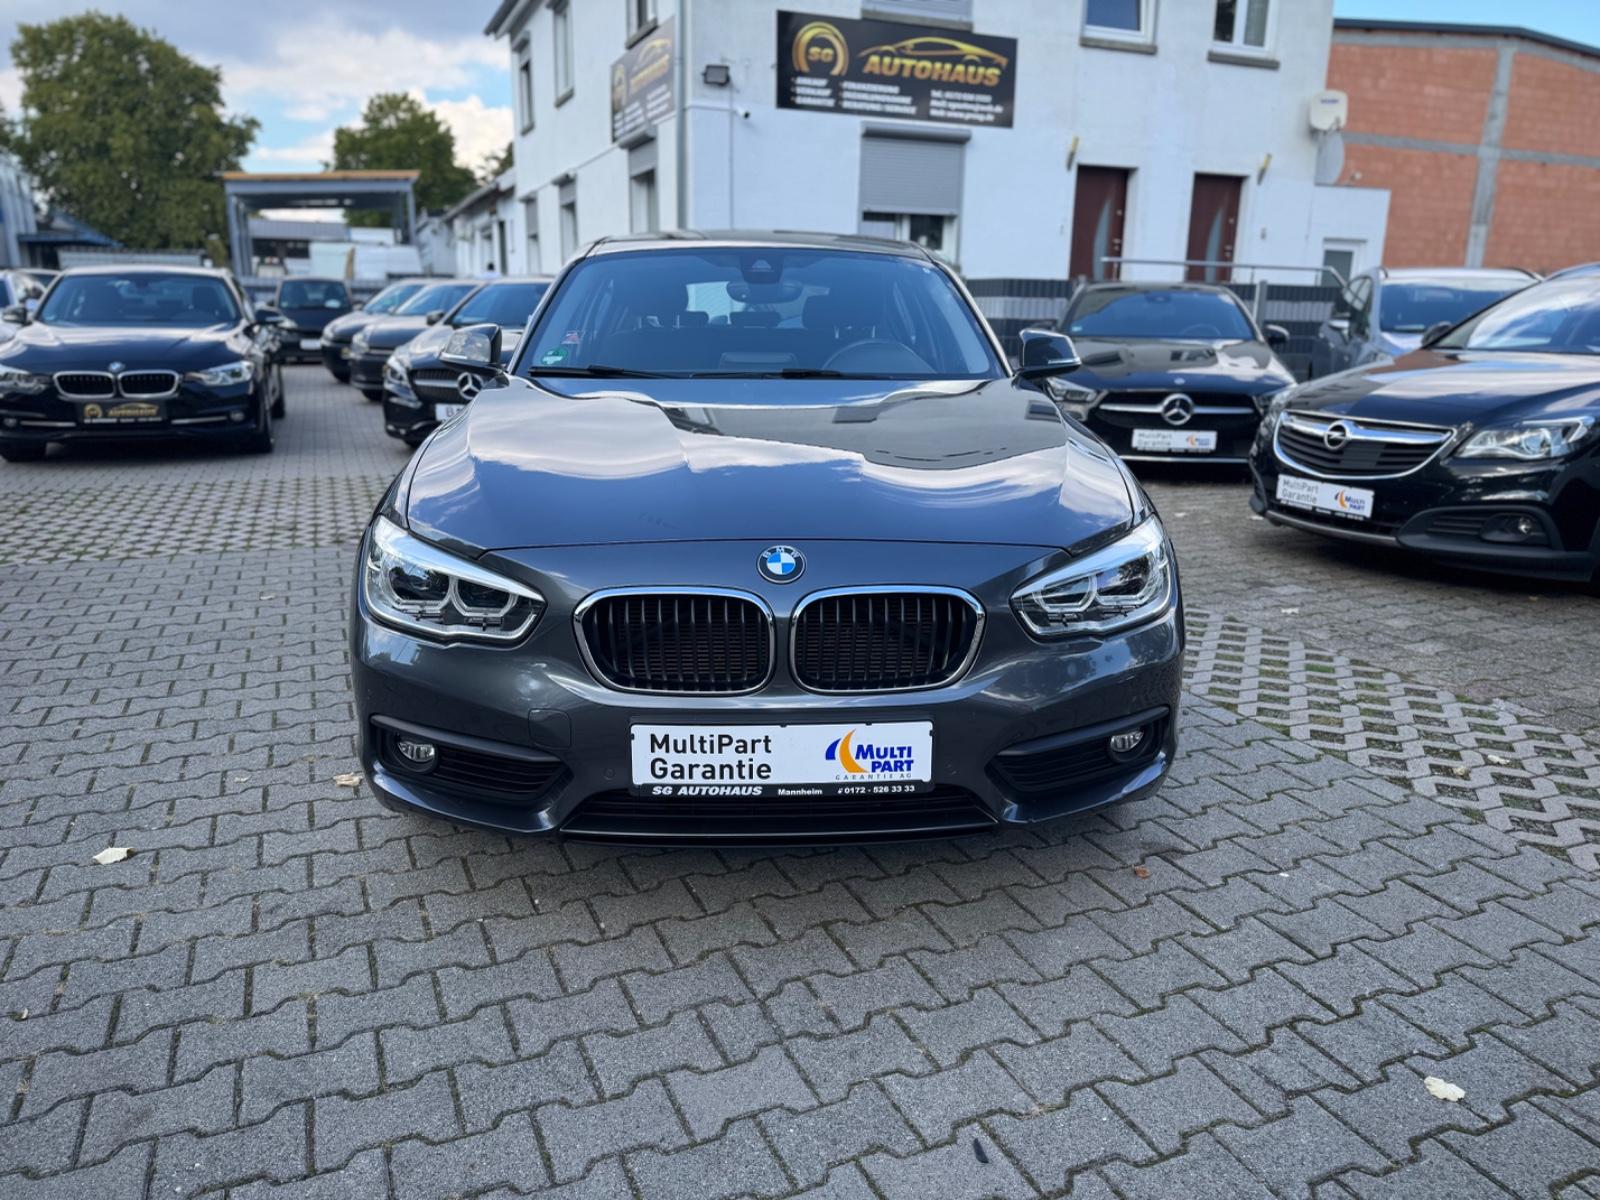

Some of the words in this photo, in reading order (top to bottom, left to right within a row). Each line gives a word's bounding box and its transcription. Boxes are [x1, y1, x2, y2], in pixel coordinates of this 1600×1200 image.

[863, 55, 1001, 87] AUTOHAUS
[650, 733, 772, 755] MultiPart
[855, 744, 912, 760] MULTI
[650, 757, 772, 780] Garantie
[871, 760, 914, 773] PART
[652, 786, 673, 795] SG
[677, 786, 763, 796] AUTOHAUS
[777, 788, 823, 796] Mannheim
[891, 785, 902, 793] 33
